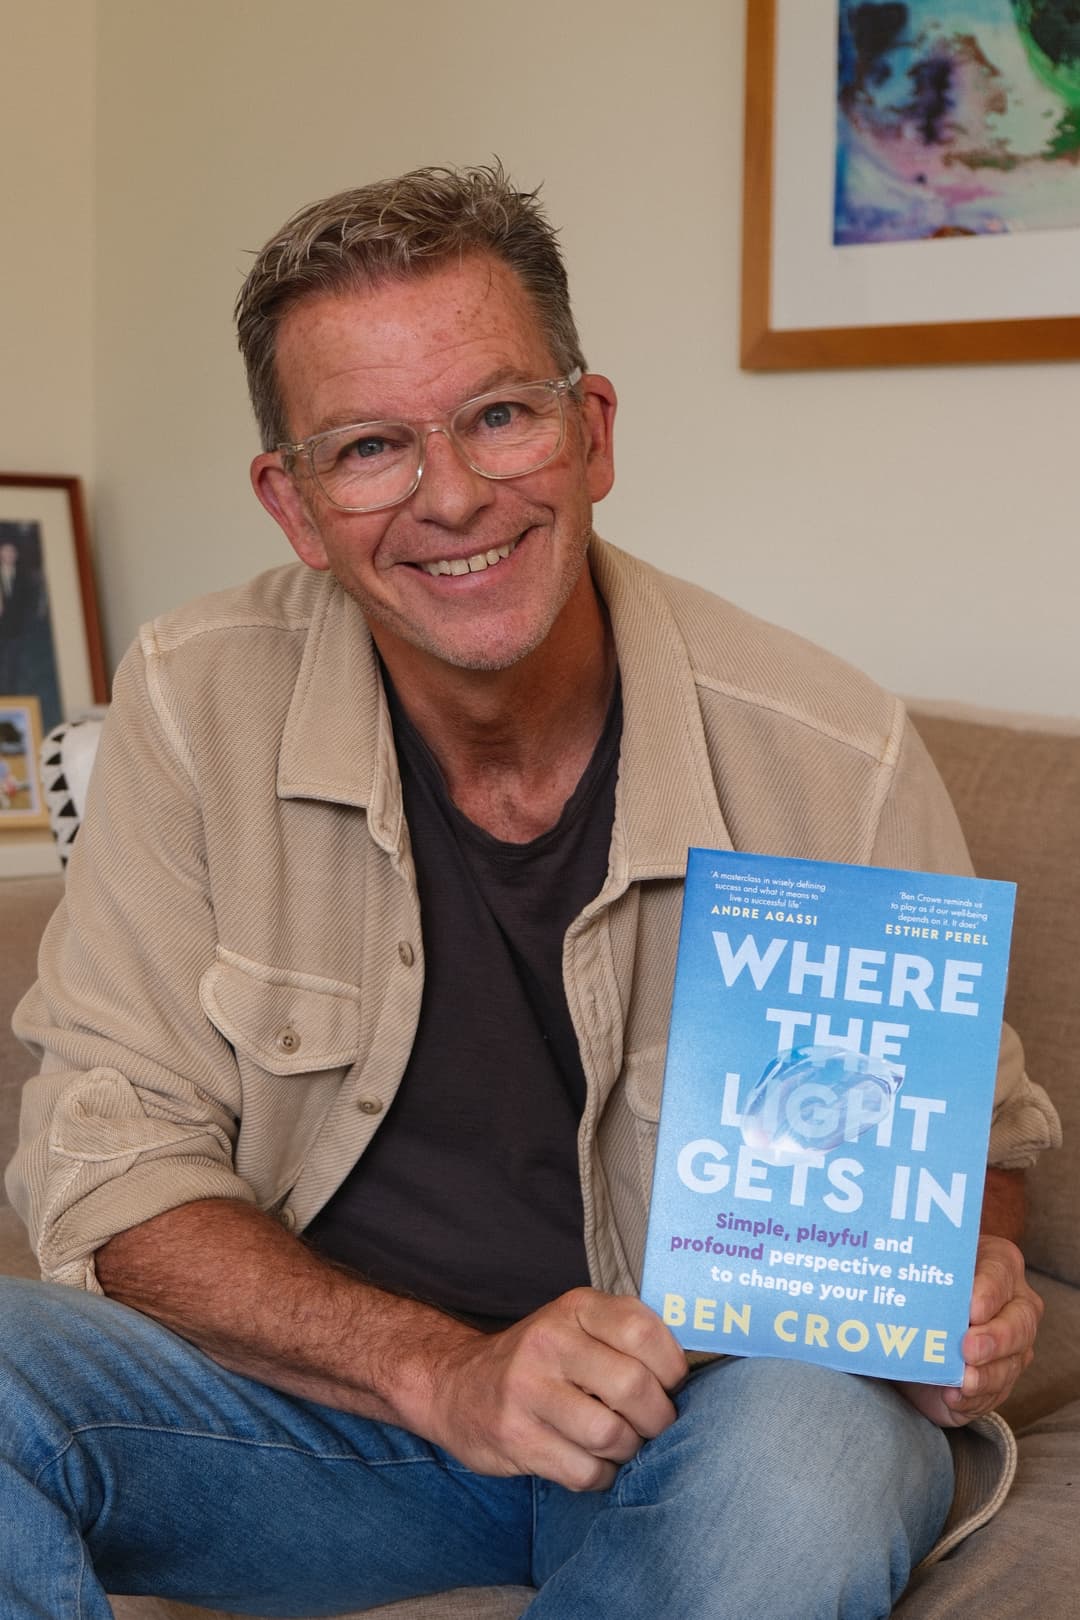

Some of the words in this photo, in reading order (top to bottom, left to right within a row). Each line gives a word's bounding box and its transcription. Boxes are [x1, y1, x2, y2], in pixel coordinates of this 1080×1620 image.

[720, 873, 760, 883] masterclass
[772, 878, 794, 888] wisely
[796, 881, 826, 892] defining
[751, 898, 786, 907] successful
[917, 894, 941, 903] Crowe
[944, 898, 972, 907] reminds
[711, 905, 759, 919] ANDRE
[765, 912, 818, 925] AGASSI
[898, 914, 929, 924] depends
[900, 904, 916, 913] play
[951, 910, 988, 921] well-being
[885, 924, 939, 940] ESTHER
[945, 931, 988, 945] PEREL
[712, 931, 983, 1016] WHERE
[765, 1008, 910, 1084] THE
[720, 1072, 947, 1152] LIGHT
[676, 1138, 864, 1213] GETS
[890, 1165, 967, 1228] IN
[716, 1212, 790, 1241] Simple,
[796, 1223, 868, 1248] playful
[874, 1236, 913, 1254] and
[670, 1236, 764, 1260] profound
[769, 1248, 892, 1278] perspective
[898, 1263, 954, 1286] shifts
[711, 1266, 733, 1283] to
[739, 1271, 814, 1296] change
[818, 1285, 868, 1302] your
[873, 1286, 906, 1307] life
[663, 1293, 752, 1336] BEN
[774, 1311, 948, 1364] CROWE
